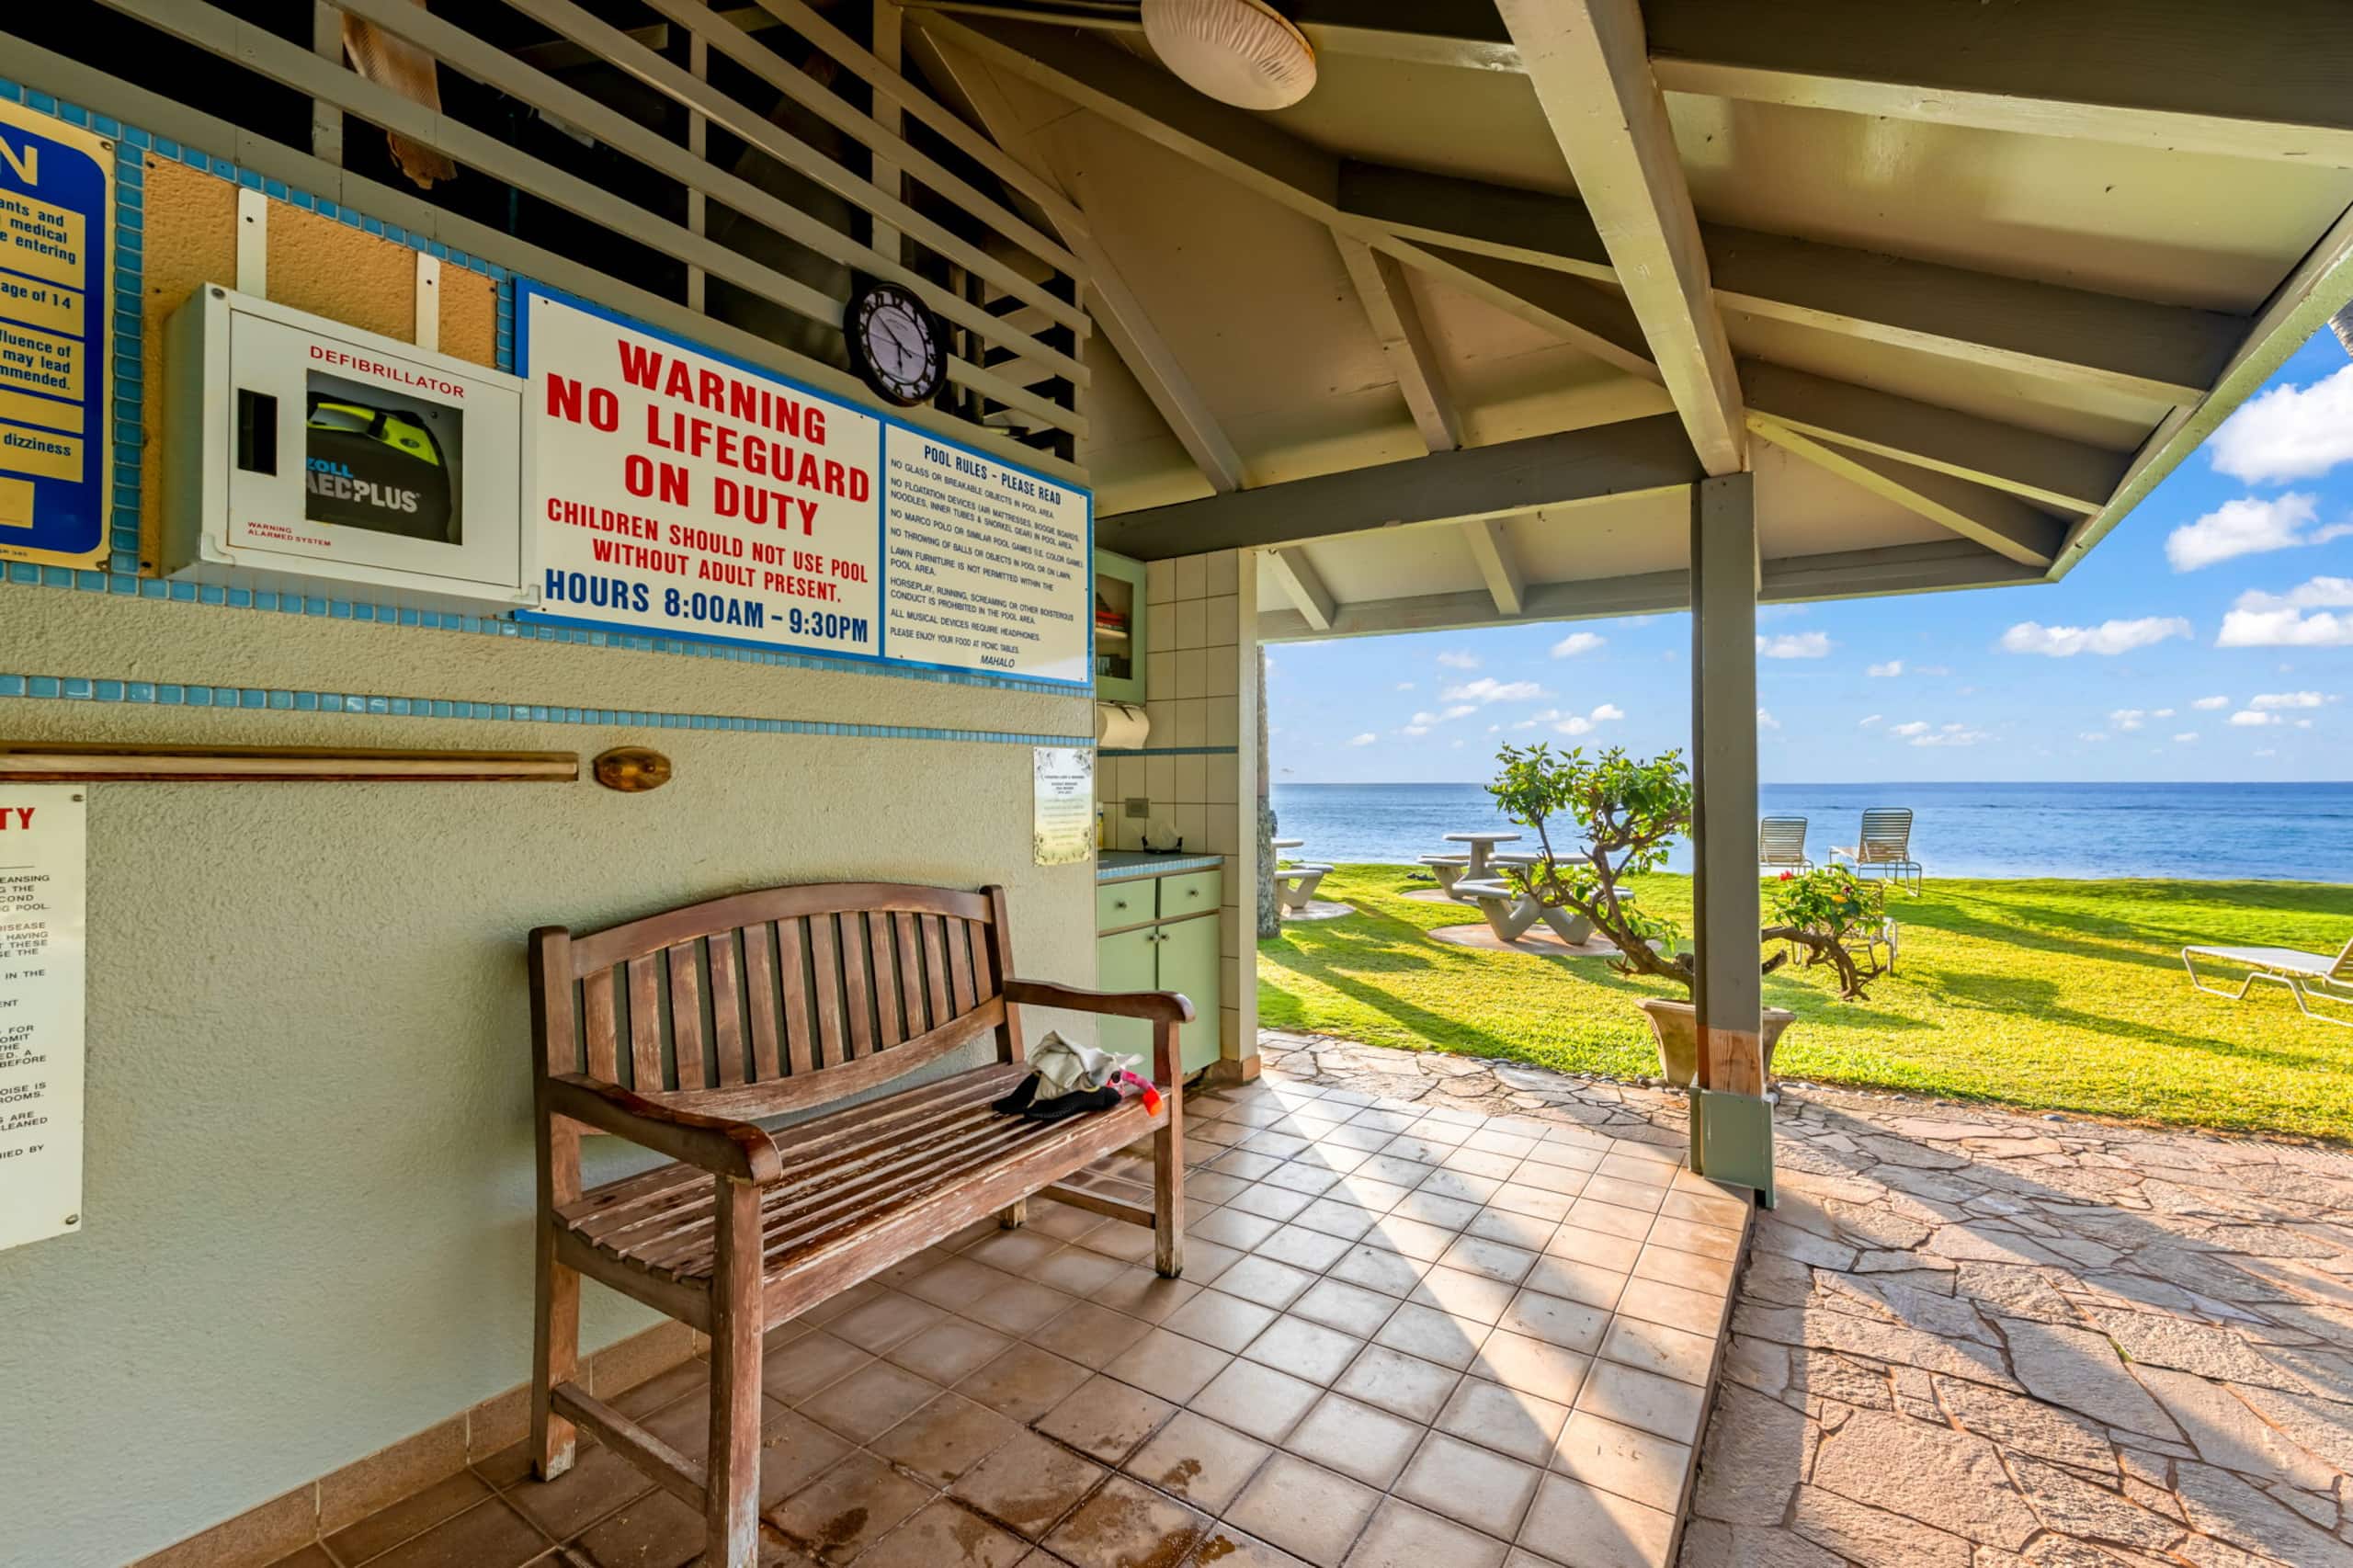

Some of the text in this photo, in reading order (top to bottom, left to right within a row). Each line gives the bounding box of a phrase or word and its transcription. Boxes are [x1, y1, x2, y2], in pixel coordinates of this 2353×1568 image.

[10, 219, 67, 244] medical
[38, 211, 63, 227] and
[16, 236, 75, 265] entering
[1, 282, 71, 309] age of 14
[4, 350, 70, 374] may lead
[57, 345, 71, 358] of
[310, 346, 464, 398] DEFIBRILLATOR
[618, 338, 824, 446] WARNING
[4, 433, 71, 456] dizziness
[546, 370, 869, 504] NO LIFEGUARD
[891, 459, 1053, 518] NO GLASS OR BREAKABLE OBJECTS IN POOL AREA.
[925, 445, 950, 468] POOL
[956, 456, 986, 480] RULES
[1001, 472, 1034, 496] PLEASE
[1039, 485, 1060, 505] READ
[624, 451, 818, 538] ON DUTY
[891, 477, 901, 488] NO
[904, 482, 945, 501] FLOATATION
[948, 494, 975, 510] DEVICES
[1034, 521, 1054, 534] BOOGIE
[248, 522, 292, 534] WARNING
[891, 508, 901, 518] NO
[904, 512, 930, 527] MARCO
[933, 519, 951, 532] POLO
[954, 526, 963, 536] OR
[966, 528, 991, 543] SIMILAR
[993, 536, 1008, 548] POOL
[1012, 541, 1031, 553] GAMES
[1046, 551, 1063, 562] COLOR
[930, 502, 950, 515] INNER
[953, 508, 973, 522] TUBES
[977, 516, 981, 524] &
[984, 517, 1012, 532] SNORKEL
[1015, 527, 1031, 539] GEAR)
[1034, 532, 1039, 540] IN
[1041, 534, 1055, 545] POOL
[248, 529, 332, 546] ALARMED SYSTEM
[547, 496, 868, 583] CHILDREN SHOULD NOT USE POOL
[891, 527, 901, 538] NO
[904, 530, 939, 547] THROWING
[942, 540, 949, 550] OF
[953, 542, 972, 555] BALLS
[974, 548, 983, 558] OR
[985, 551, 1011, 564] OBJECTS
[1014, 558, 1018, 567] IN
[1021, 560, 1036, 571] POOL
[1038, 564, 1044, 573] OR
[1047, 566, 1054, 575] ON
[592, 538, 841, 602] WITHOUT ADULT PRESENT.
[891, 558, 936, 575] POOL AREA.
[891, 546, 1053, 591] LAWN FURNITURE IS NOT PERMITTED WITHIN THE
[545, 567, 649, 613] HOURS
[664, 586, 763, 628] 8:00AM
[790, 607, 868, 642] 9:30PM
[890, 577, 934, 595] HORSEPLAY,
[971, 594, 1006, 608] SCREAMING
[1008, 601, 1017, 609] OR
[1019, 604, 1038, 614] OTHER
[891, 589, 1035, 624] CONDUCT IS PROHIBITED IN THE POOL AREA.
[891, 608, 904, 618] ALL
[906, 611, 938, 624] MUSICAL
[940, 617, 968, 629] DEVICES
[971, 622, 997, 633] REQUIRE
[890, 627, 914, 638] PLEASE
[916, 631, 934, 641] ENJOY
[938, 634, 952, 643] YOUR
[955, 636, 971, 646] FOOD
[972, 639, 979, 647] AT
[981, 641, 997, 650] PICNIC
[980, 654, 1015, 667] MAHALO
[6, 932, 48, 940] HAVING
[10, 940, 47, 949] THESE
[23, 970, 44, 978] THE
[9, 1025, 34, 1033] FOR
[11, 1111, 34, 1121] ARE
[29, 1143, 44, 1153] BY
